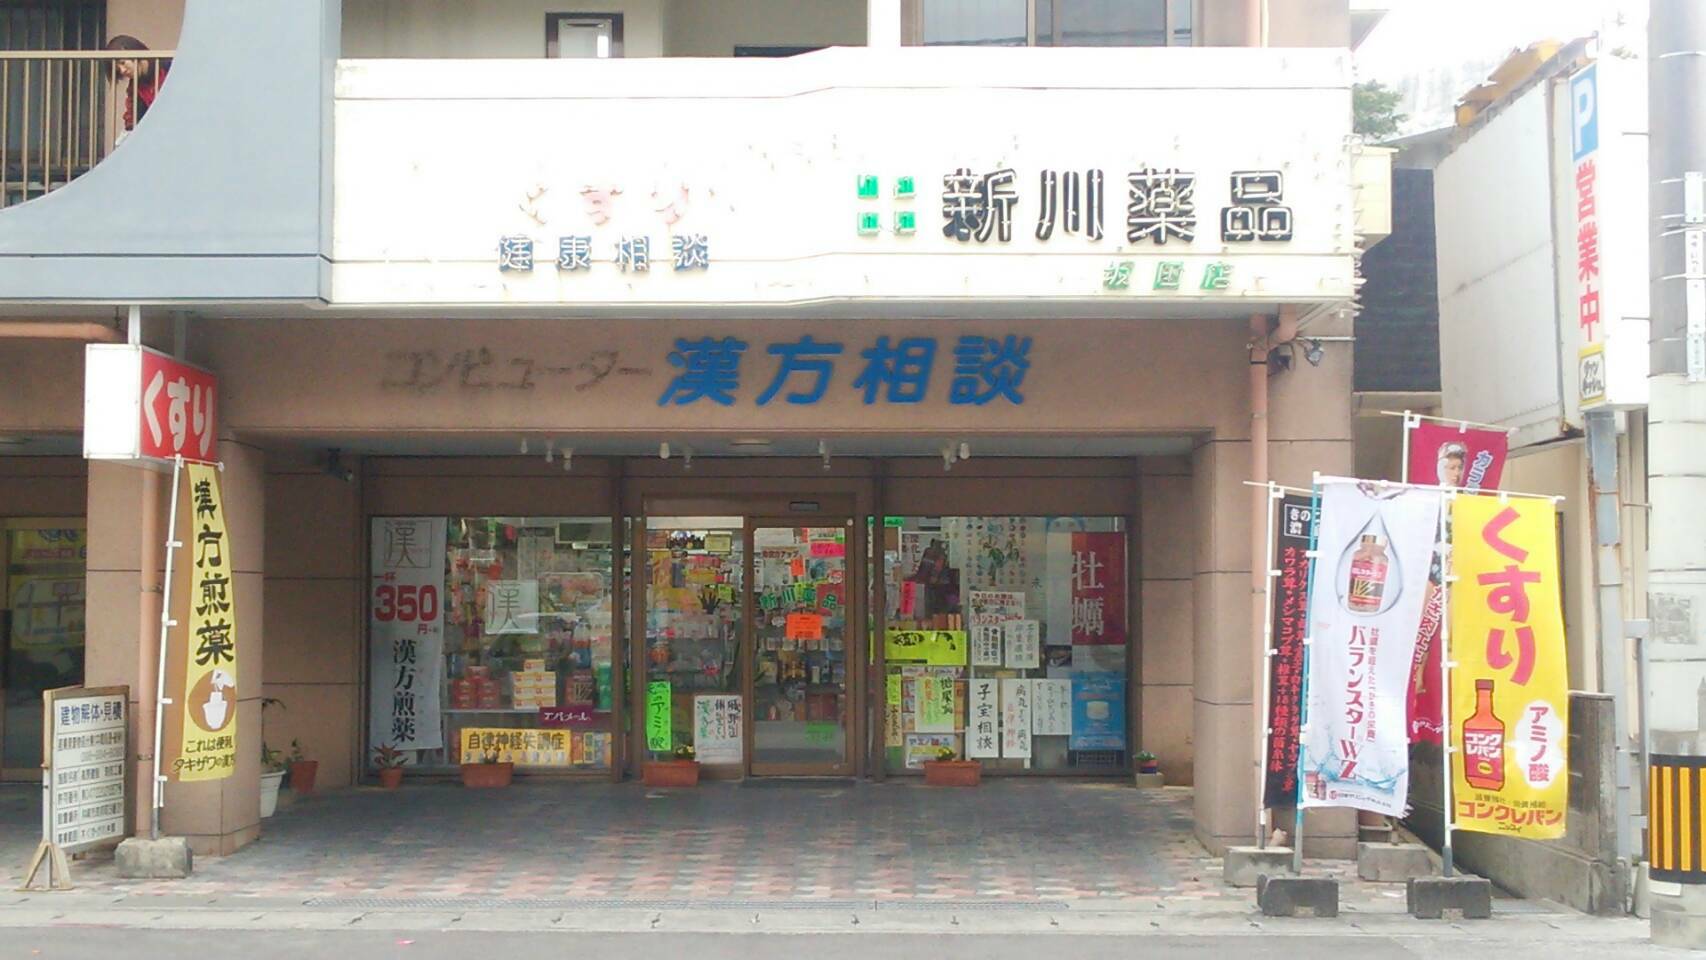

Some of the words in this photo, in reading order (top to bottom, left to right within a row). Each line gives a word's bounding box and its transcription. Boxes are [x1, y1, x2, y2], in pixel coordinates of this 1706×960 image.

[1573, 83, 1595, 152] P
[942, 167, 1293, 244] 新川薬品
[499, 235, 710, 272] 健康相談
[1575, 160, 1600, 342] 営業中
[658, 335, 1033, 406] 漢方相談
[143, 369, 213, 458] くすり
[194, 480, 234, 666] 漢方煎薬
[374, 584, 438, 622] 350
[1477, 506, 1541, 686] くすり
[391, 639, 415, 743] 漢方煎薬
[1465, 732, 1502, 747] コンク
[1529, 706, 1550, 782] アミノ酸
[1458, 800, 1563, 825] コンクレバン
